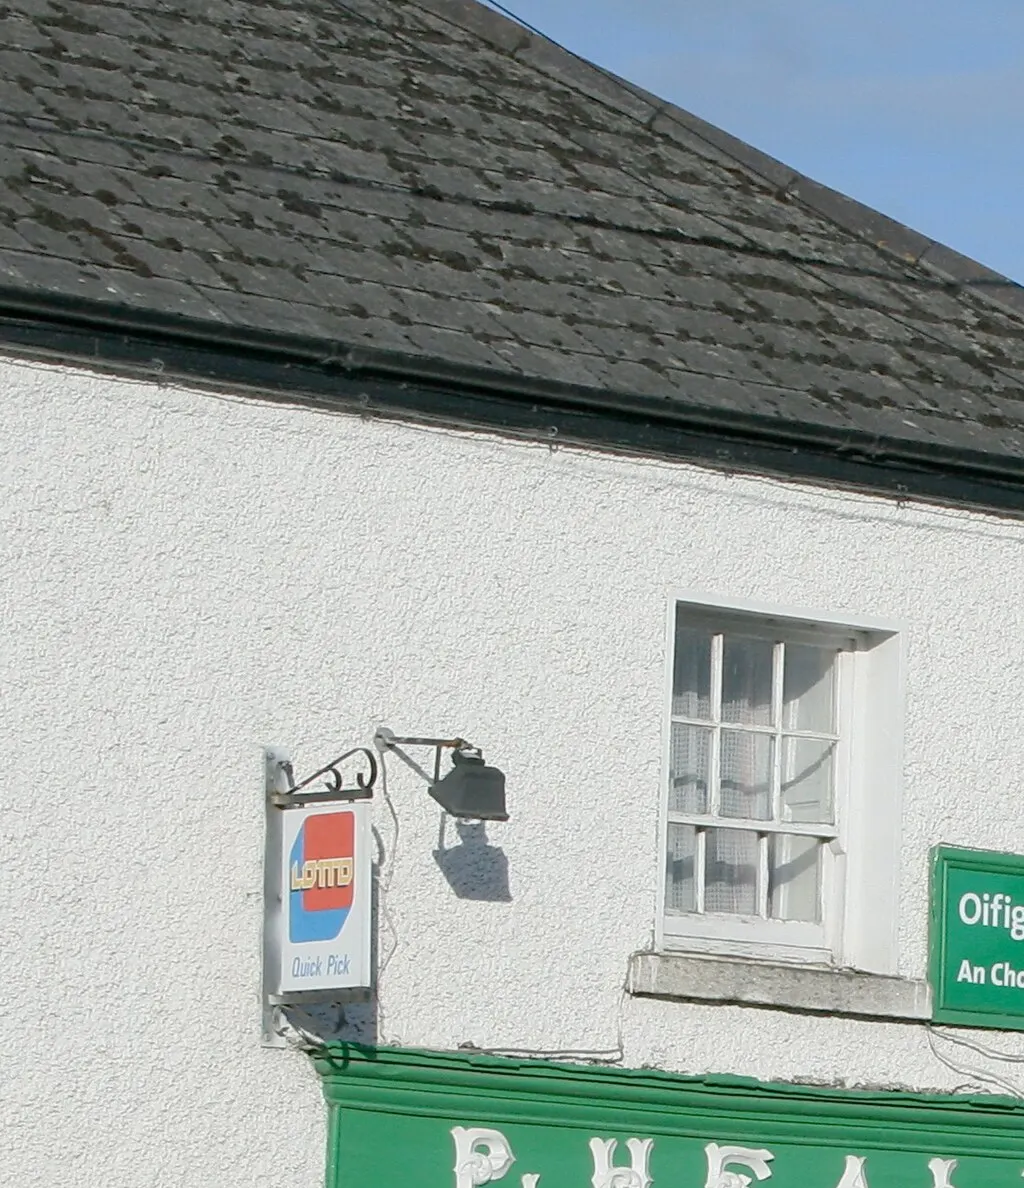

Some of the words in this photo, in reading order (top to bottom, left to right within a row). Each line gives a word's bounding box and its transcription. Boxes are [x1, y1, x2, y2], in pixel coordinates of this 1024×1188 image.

[291, 857, 353, 890] LOTTO
[291, 956, 322, 977] Quick
[326, 954, 350, 976] Pick
[957, 959, 985, 984] An
